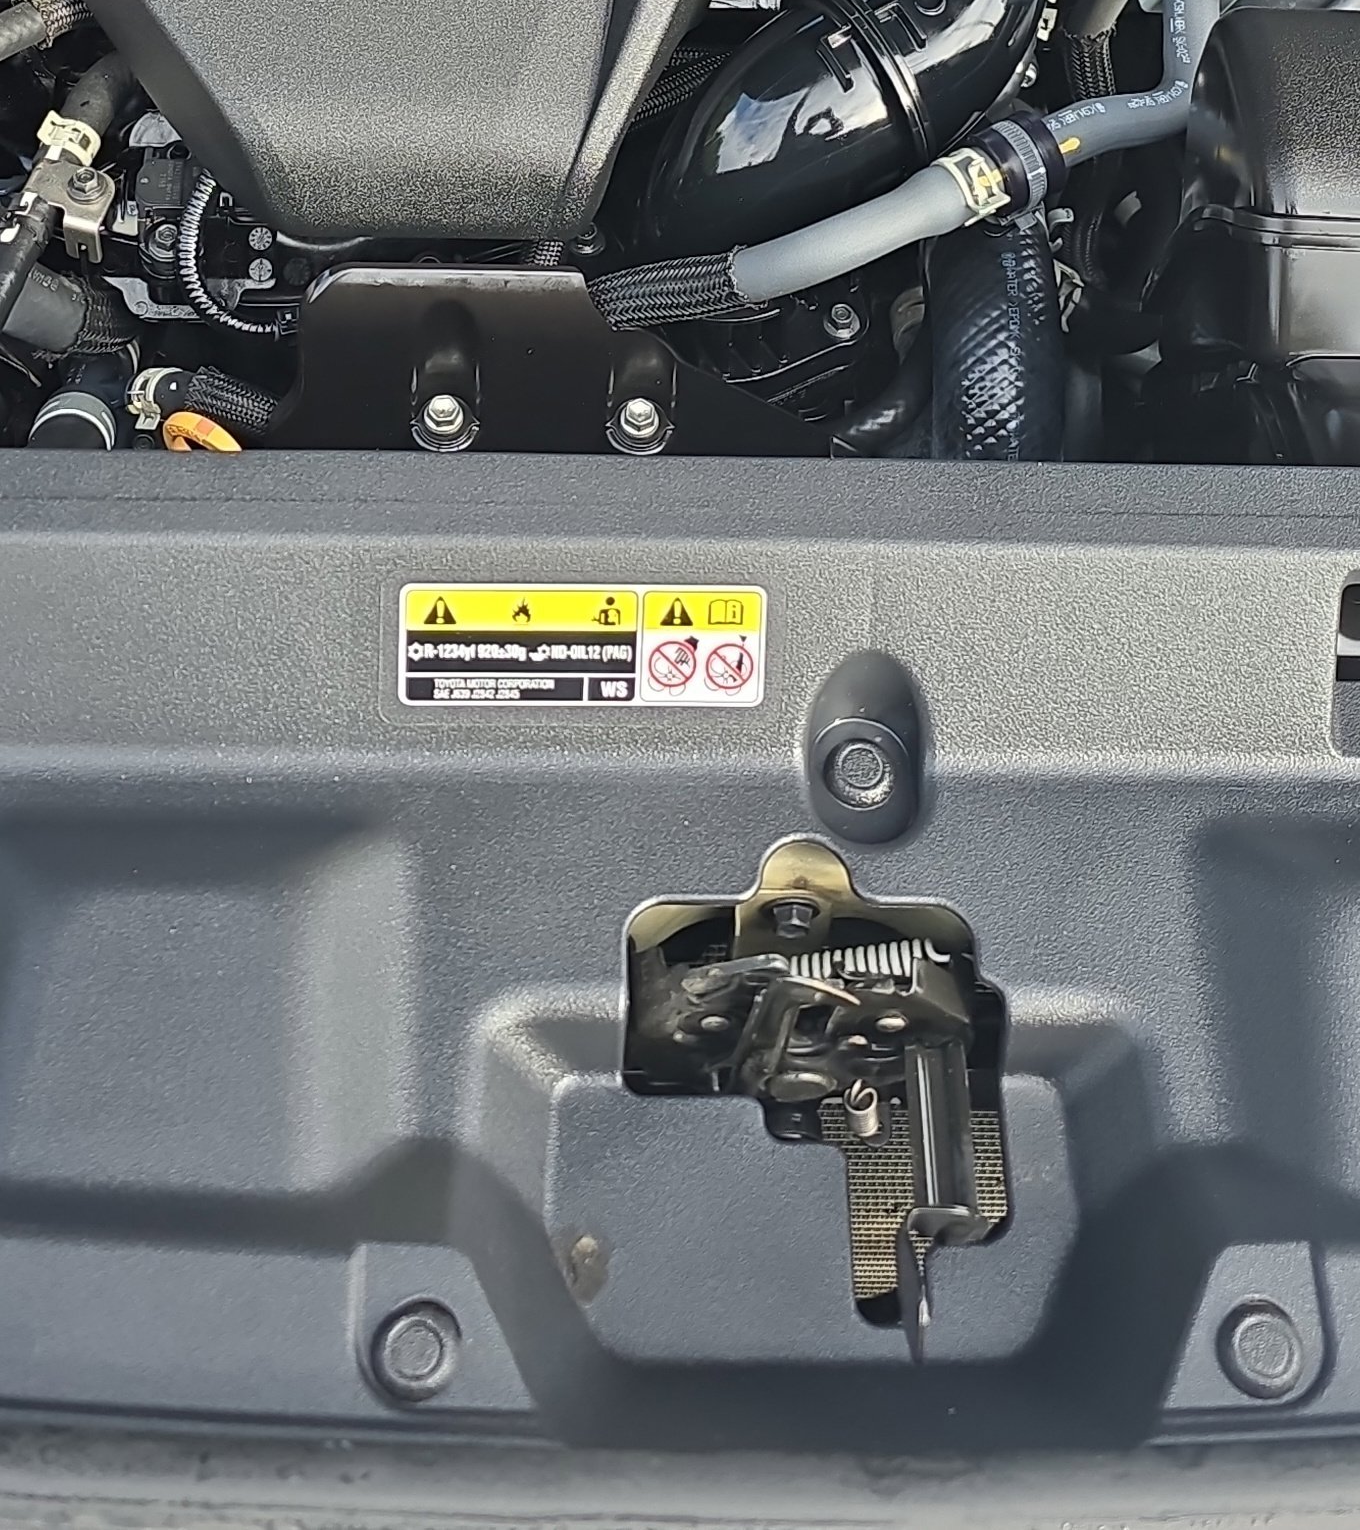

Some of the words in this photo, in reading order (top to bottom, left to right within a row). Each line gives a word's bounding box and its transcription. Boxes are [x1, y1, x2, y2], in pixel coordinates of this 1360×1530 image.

[602, 645, 633, 662] (PAG)
[433, 678, 466, 689] TOYOTA
[467, 678, 496, 689] MOTOR
[497, 678, 555, 689] CORPORATION
[600, 680, 628, 698] WS
[433, 689, 450, 699] SAE
